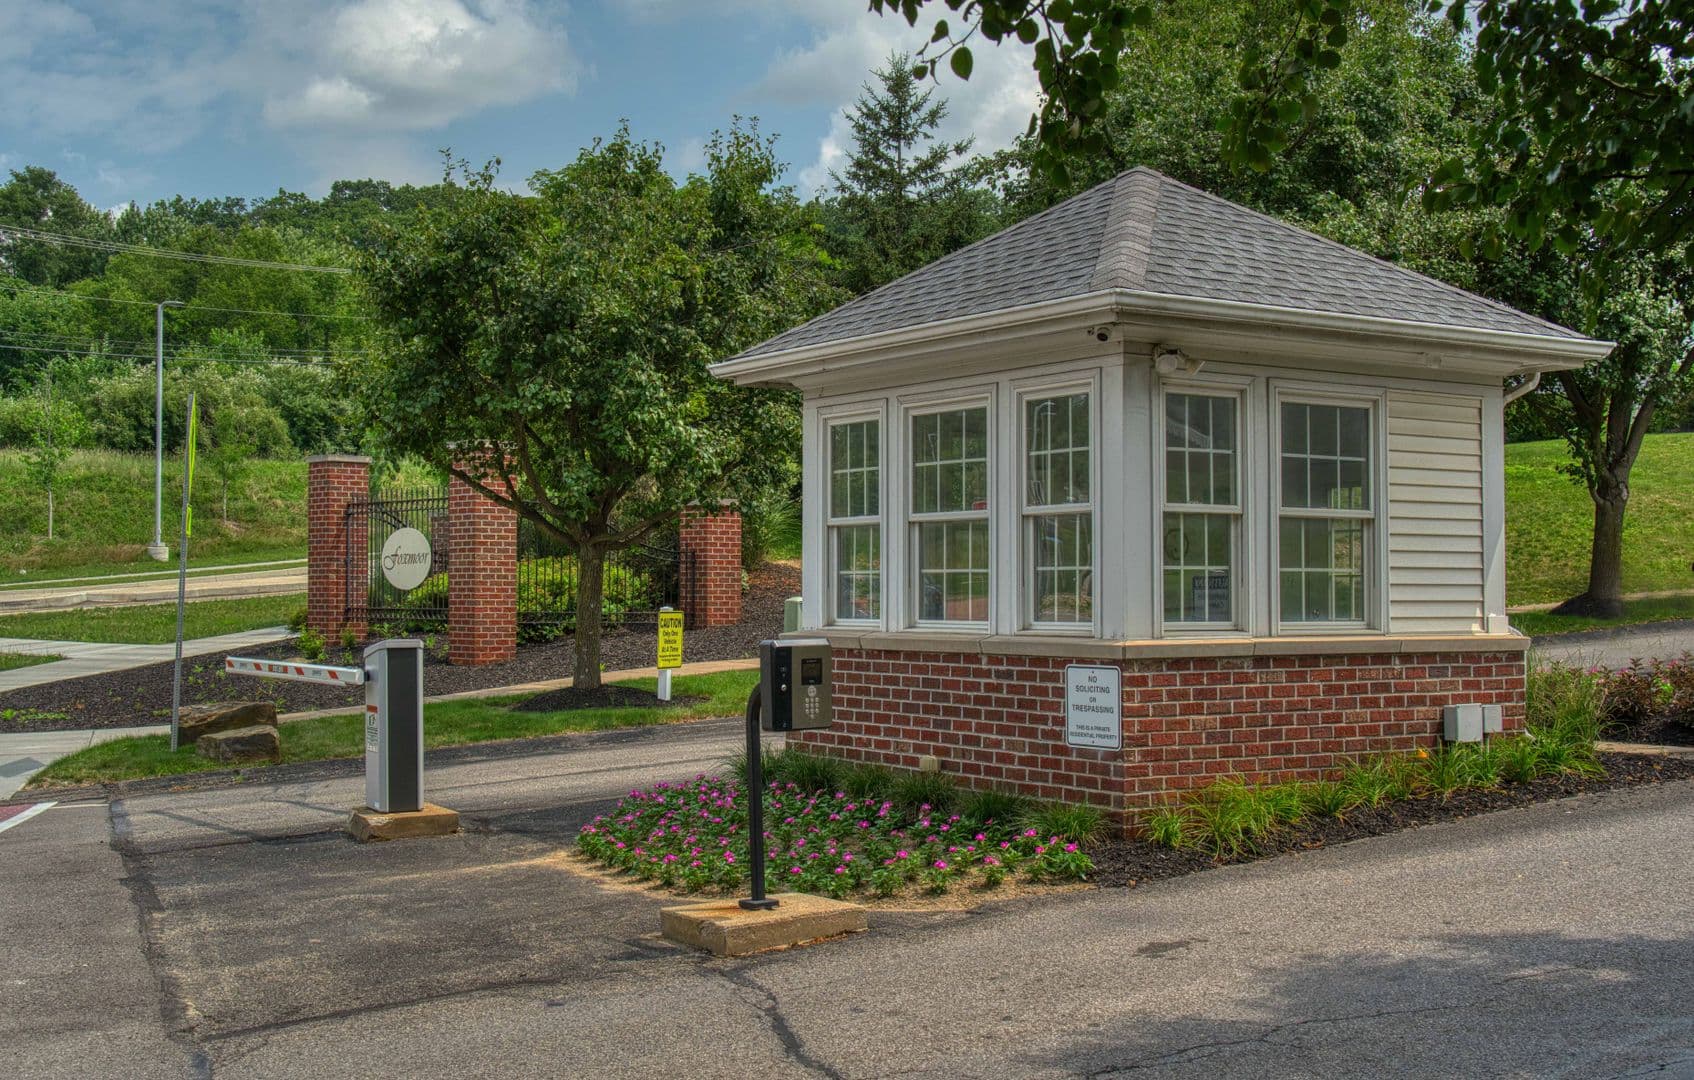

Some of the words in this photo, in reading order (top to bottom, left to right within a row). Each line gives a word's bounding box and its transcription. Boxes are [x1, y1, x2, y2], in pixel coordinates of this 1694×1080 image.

[660, 618, 682, 628] CAUTION
[1075, 685, 1110, 694] SOLICITING
[1072, 704, 1114, 714] TRESPASSING
